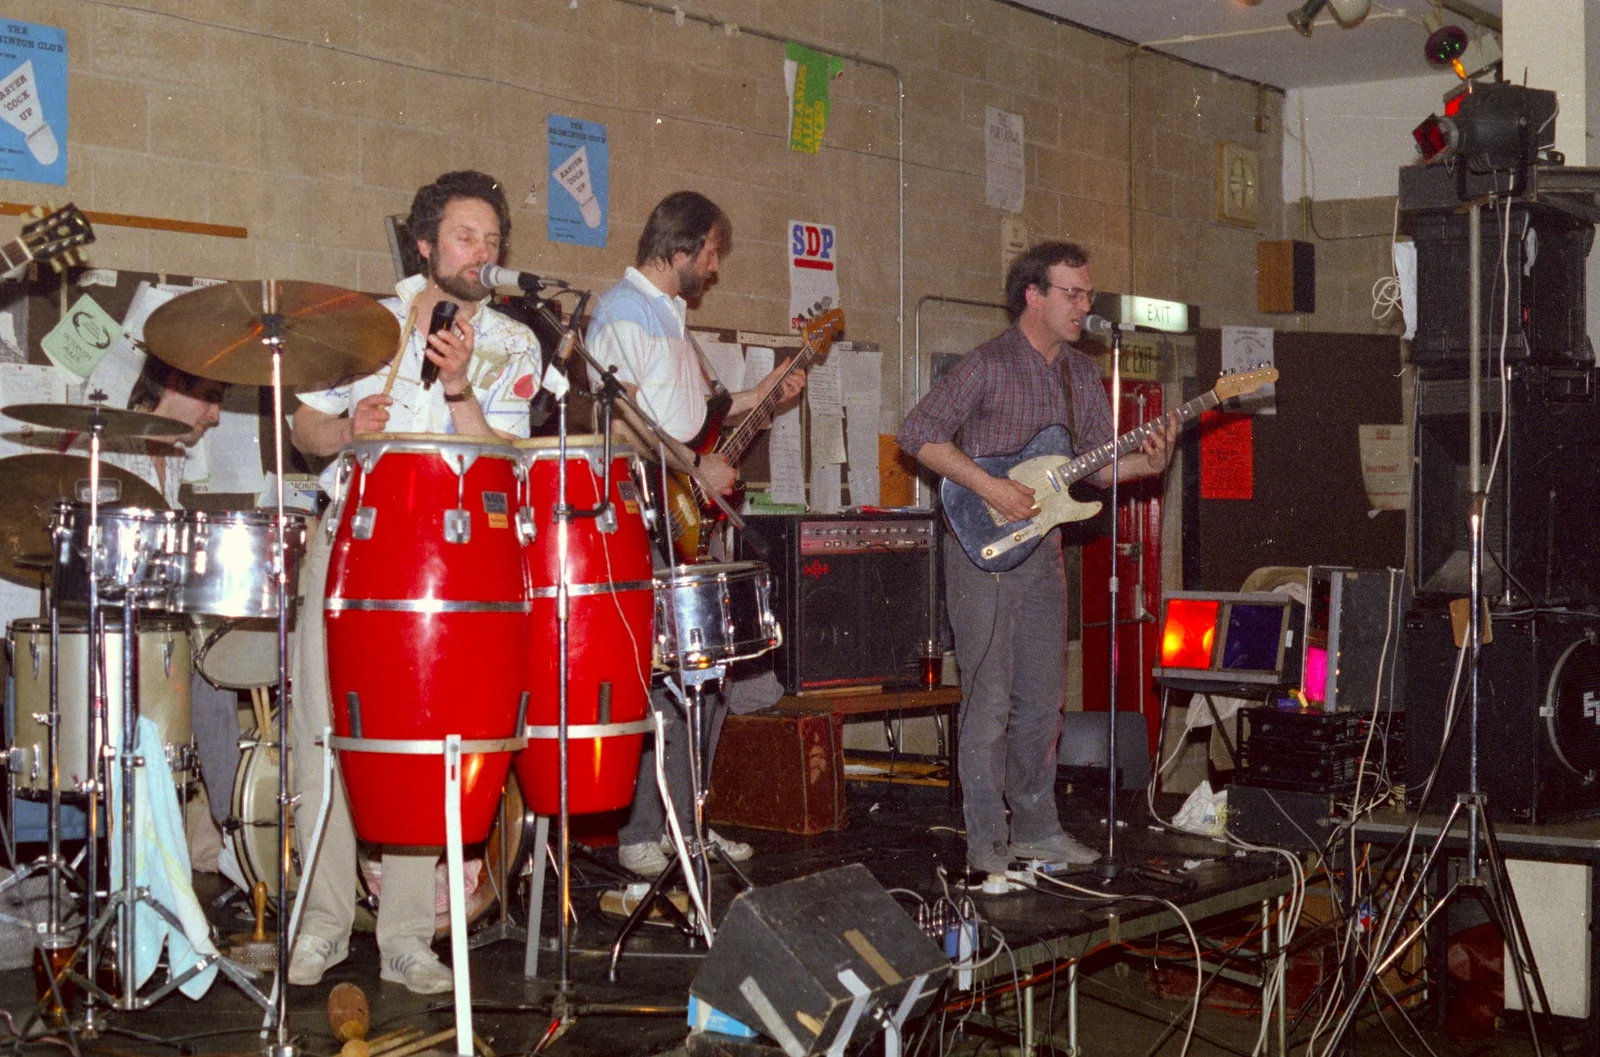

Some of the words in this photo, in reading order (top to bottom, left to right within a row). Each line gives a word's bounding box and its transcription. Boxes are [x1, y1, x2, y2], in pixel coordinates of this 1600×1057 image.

[7, 24, 28, 35] THE
[38, 41, 63, 52] CLUB
[19, 107, 33, 121] UP
[560, 157, 583, 179] EASTER
[792, 223, 834, 259] SDP
[1147, 303, 1170, 323] EXIT
